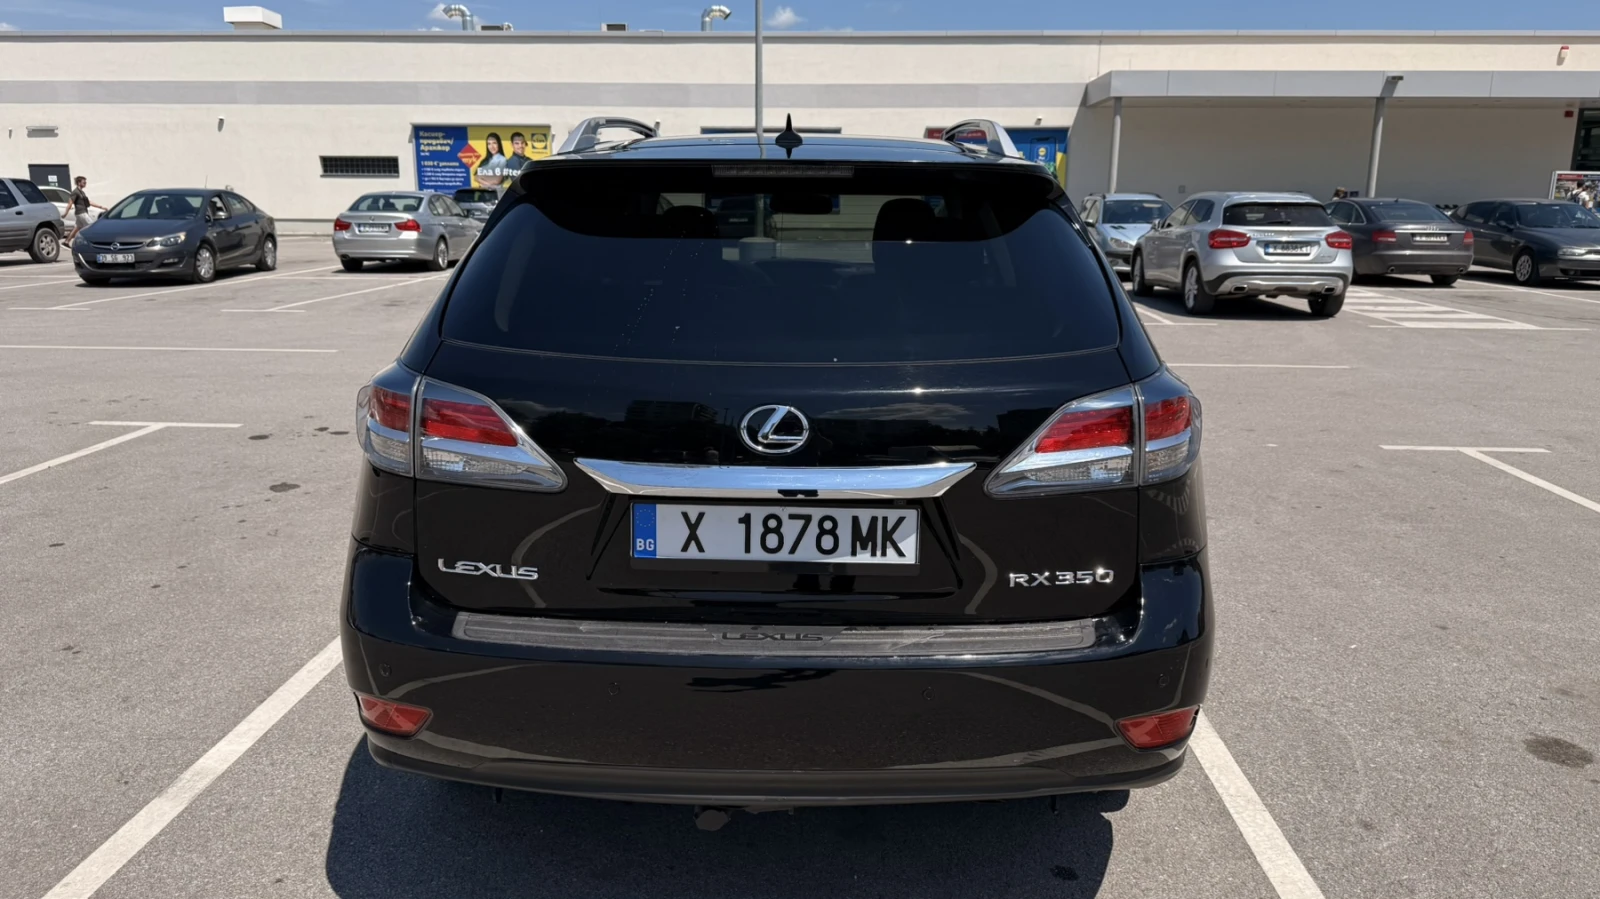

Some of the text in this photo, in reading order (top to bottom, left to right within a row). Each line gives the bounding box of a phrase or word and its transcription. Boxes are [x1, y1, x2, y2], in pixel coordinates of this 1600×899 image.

[477, 168, 494, 176] Ела
[680, 511, 907, 557] X 1878 MK
[636, 538, 655, 551] BG
[437, 558, 538, 580] LEXUS
[1009, 567, 1114, 587] RX 350
[722, 631, 823, 641] LEXUS
